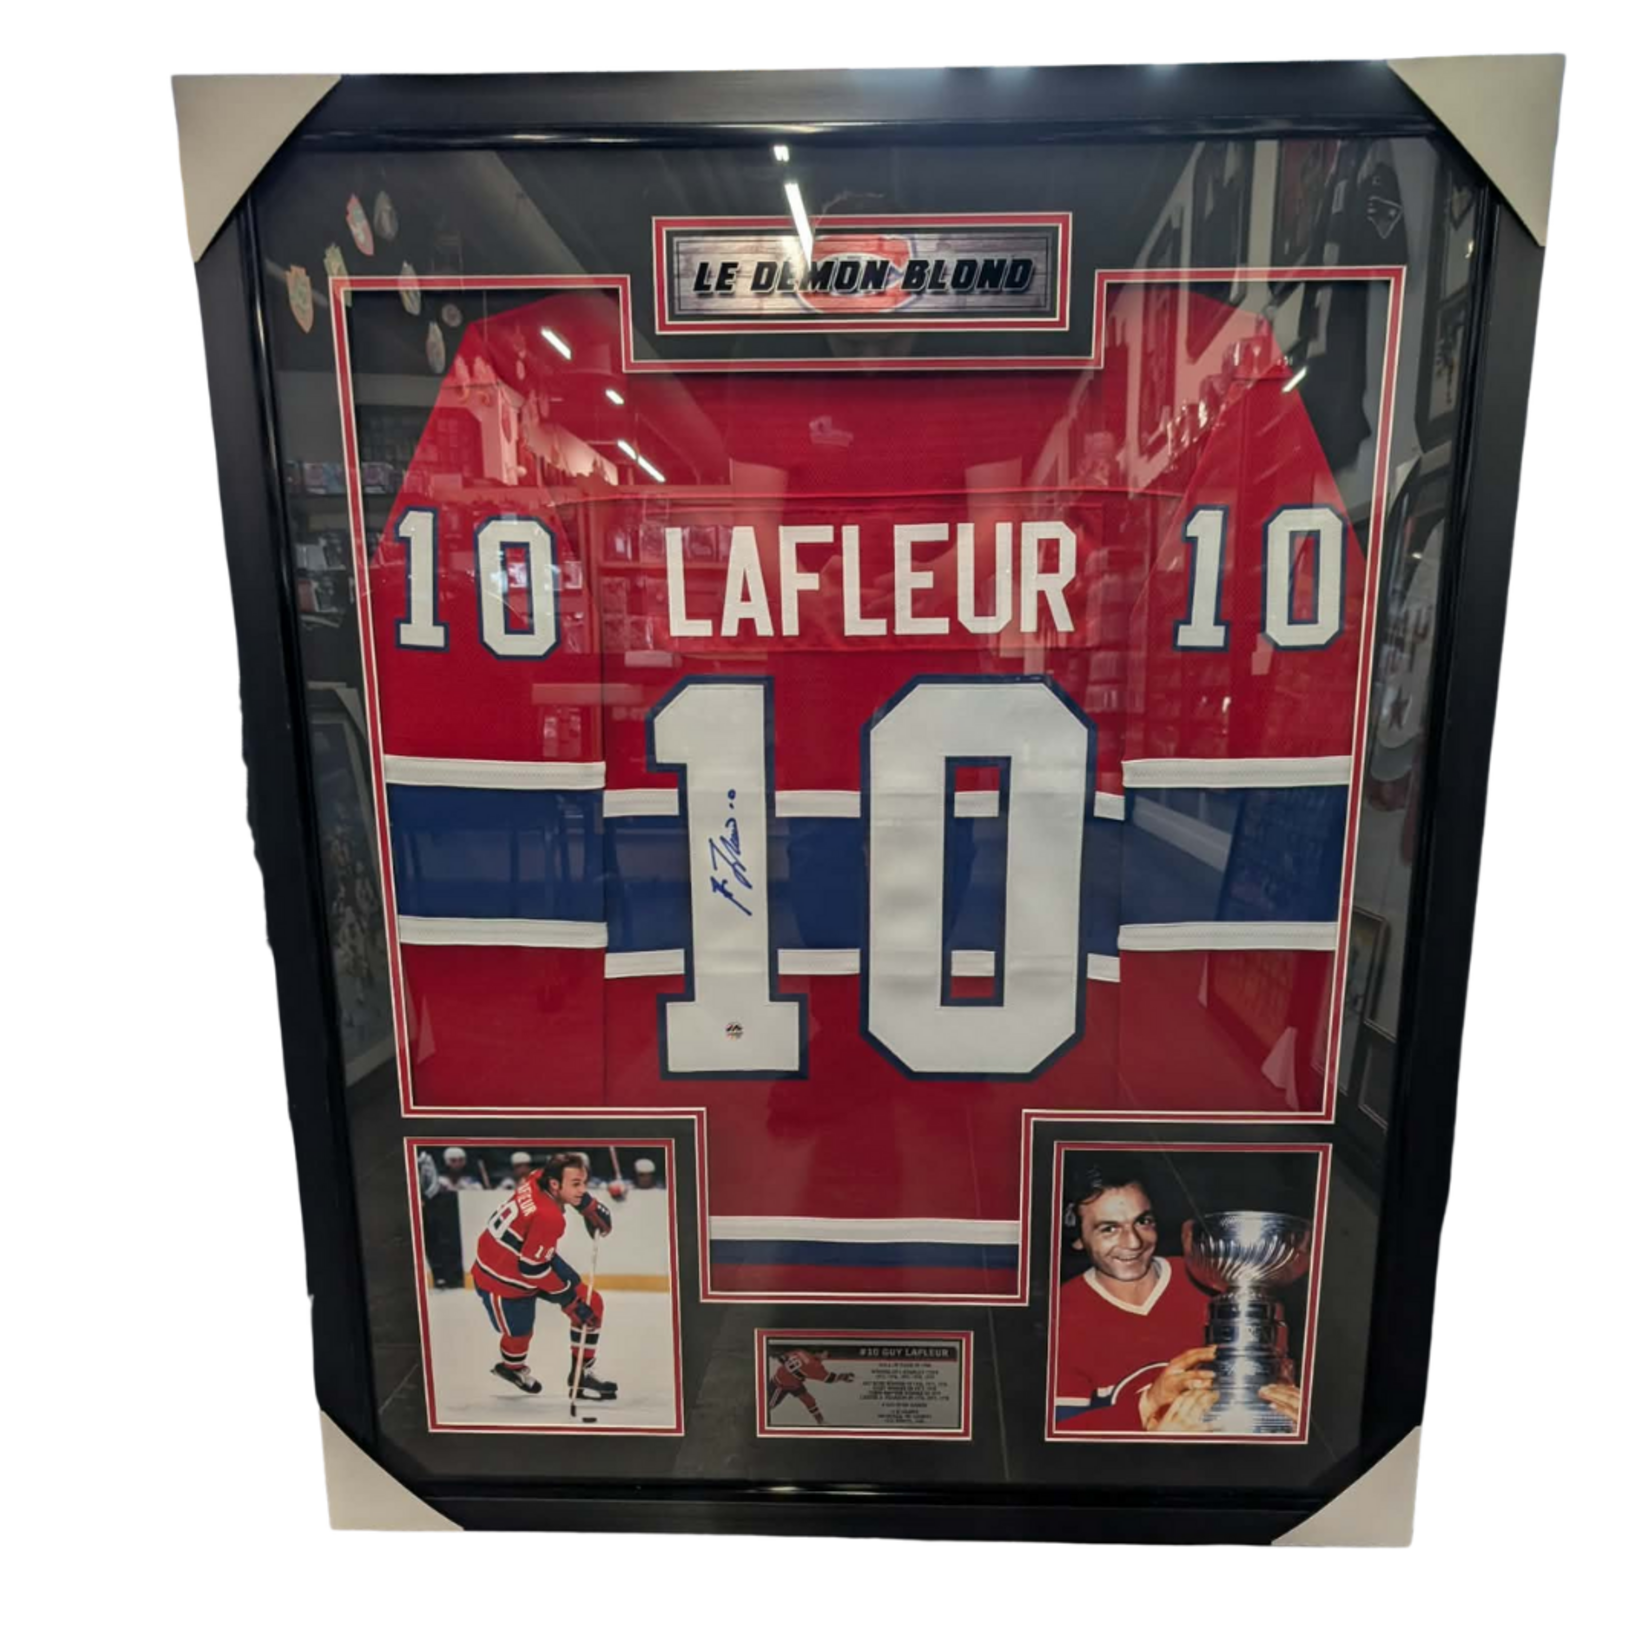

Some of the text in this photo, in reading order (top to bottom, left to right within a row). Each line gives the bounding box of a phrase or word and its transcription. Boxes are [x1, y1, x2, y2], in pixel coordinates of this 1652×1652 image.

[692, 260, 739, 293] LE
[902, 257, 1035, 292] BLOND
[395, 506, 560, 660] 10
[665, 520, 1077, 637] LAFLEUR
[1173, 504, 1348, 652] 10
[646, 674, 1097, 1080] 10
[881, 1347, 902, 1357] GUY
[904, 1348, 949, 1358] LAFLEUR
